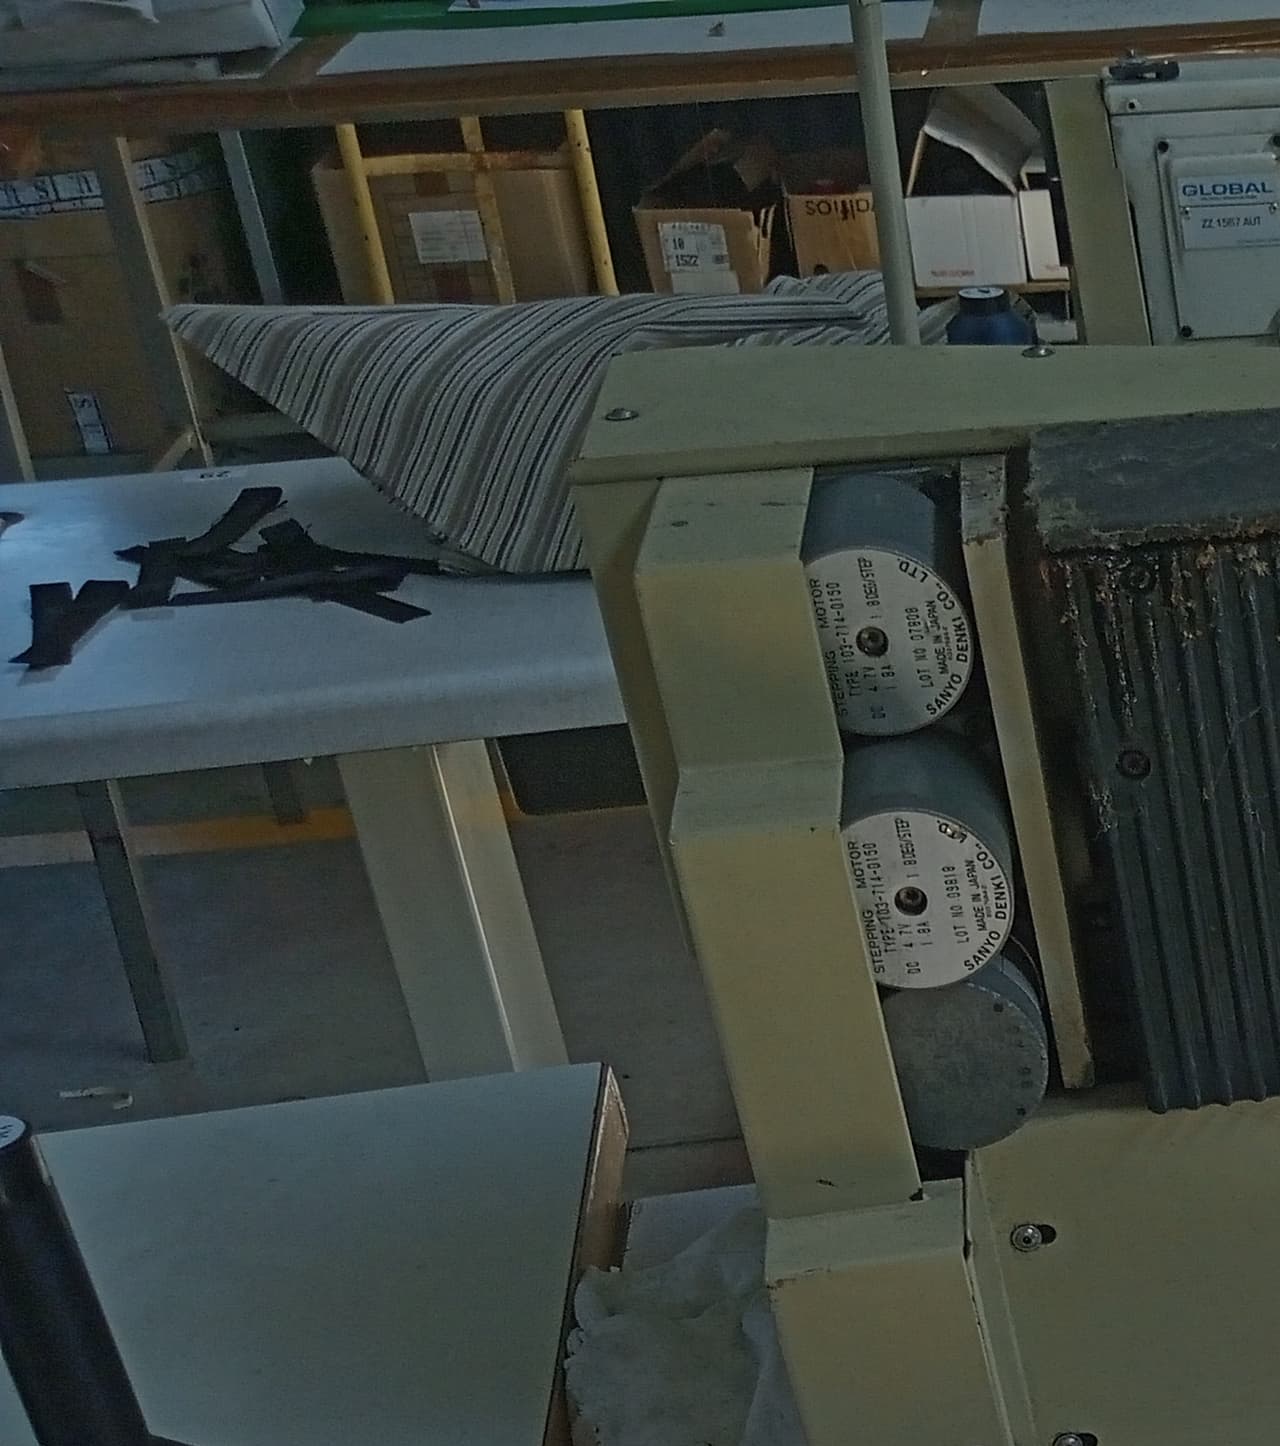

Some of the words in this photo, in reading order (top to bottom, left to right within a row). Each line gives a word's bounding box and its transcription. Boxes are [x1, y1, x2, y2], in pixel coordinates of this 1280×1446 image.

[1182, 182, 1273, 196] GLOBAL
[897, 558, 928, 583] LTD.
[810, 579, 829, 629] MOTOR
[926, 600, 941, 630] JAPAN
[932, 635, 942, 644] IN
[952, 617, 968, 662] DENKI
[935, 646, 948, 675] MADE
[926, 673, 962, 715] SANYO
[848, 841, 866, 888] MOTOR
[966, 860, 980, 890] JAPAN
[970, 893, 981, 902] IN
[964, 931, 1000, 971] SANYO
[993, 875, 1006, 920] DENKI
[973, 904, 986, 931] MADE
[863, 910, 885, 973] STEPPING
